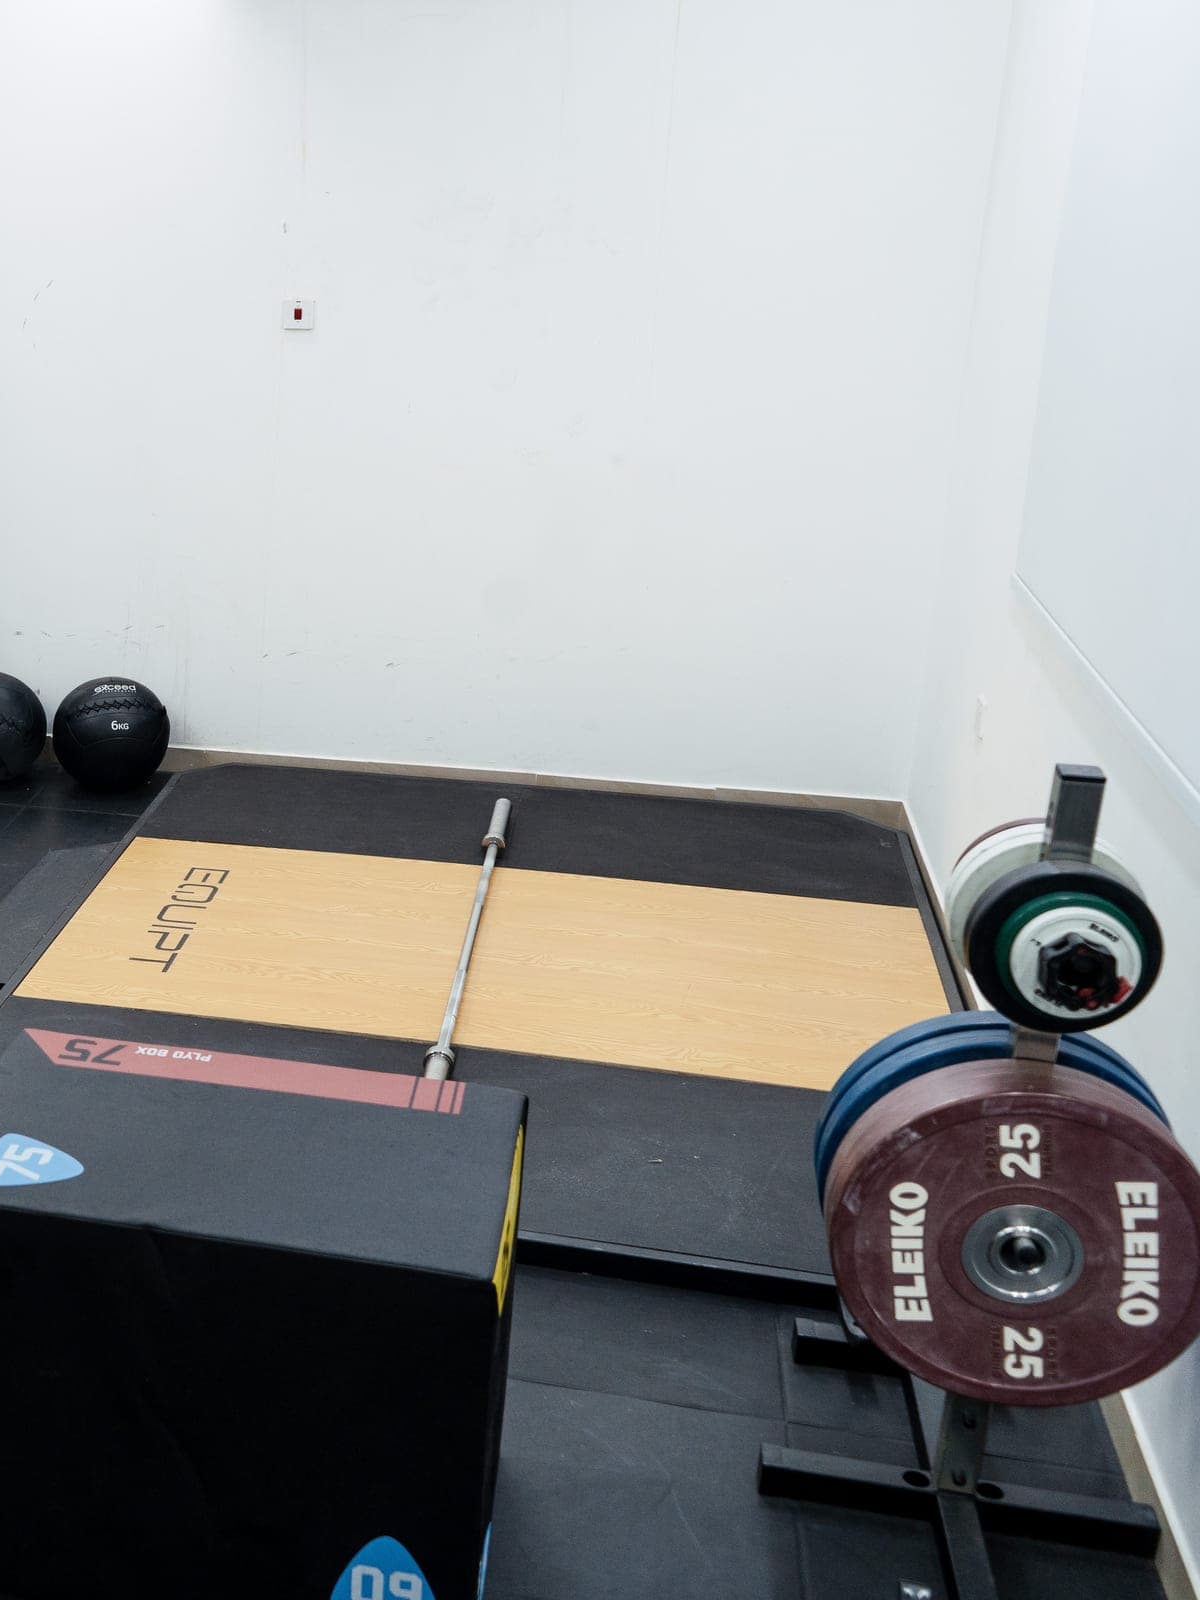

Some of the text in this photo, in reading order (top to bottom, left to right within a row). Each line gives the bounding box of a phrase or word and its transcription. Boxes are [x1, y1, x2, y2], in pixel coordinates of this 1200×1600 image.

[111, 720, 129, 730] 6KG
[57, 1038, 212, 1066] PLYO BOX 75
[999, 1123, 1041, 1179] 25
[889, 1182, 933, 1321] ELEIKO
[1115, 1181, 1159, 1326] ELEIKO
[1003, 1326, 1043, 1378] 25
